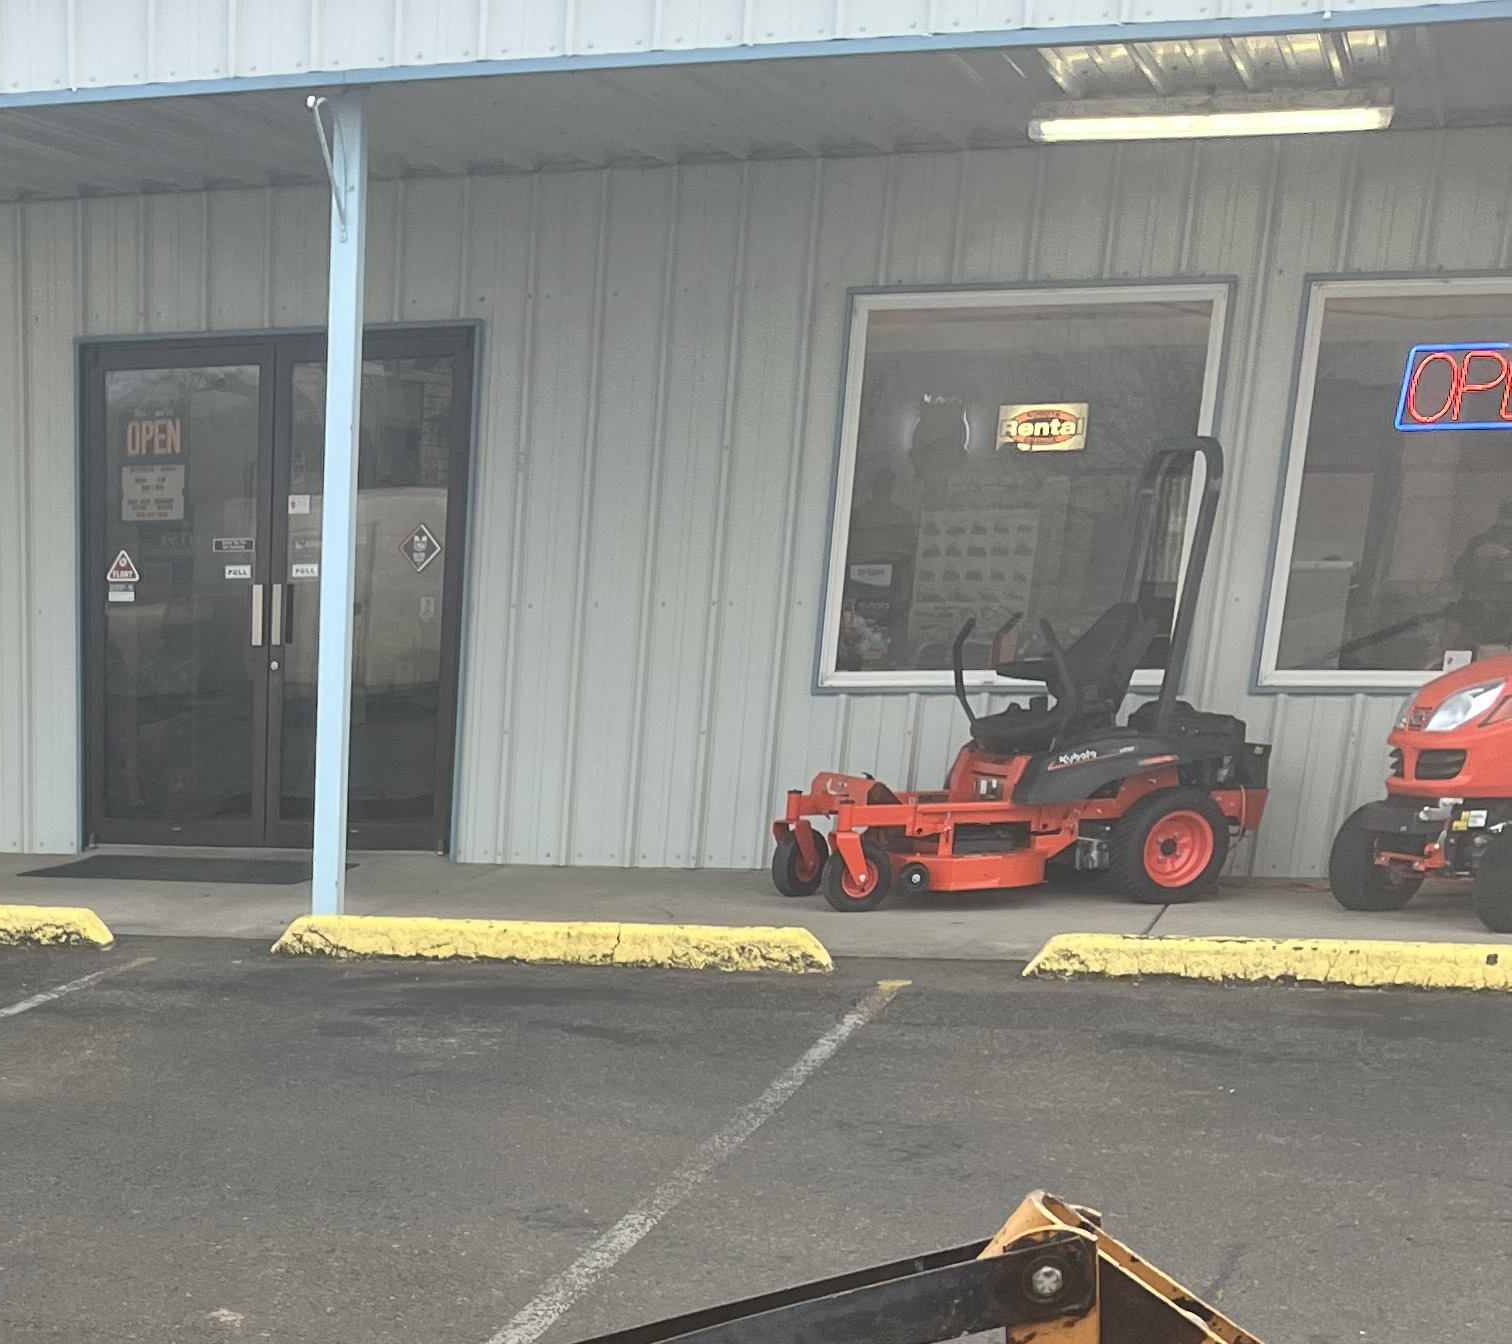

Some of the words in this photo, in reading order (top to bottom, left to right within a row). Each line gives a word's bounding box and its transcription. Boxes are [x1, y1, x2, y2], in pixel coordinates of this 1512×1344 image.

[1408, 350, 1512, 423] OP
[126, 418, 181, 456] OPEN
[1002, 418, 1083, 437] Rental
